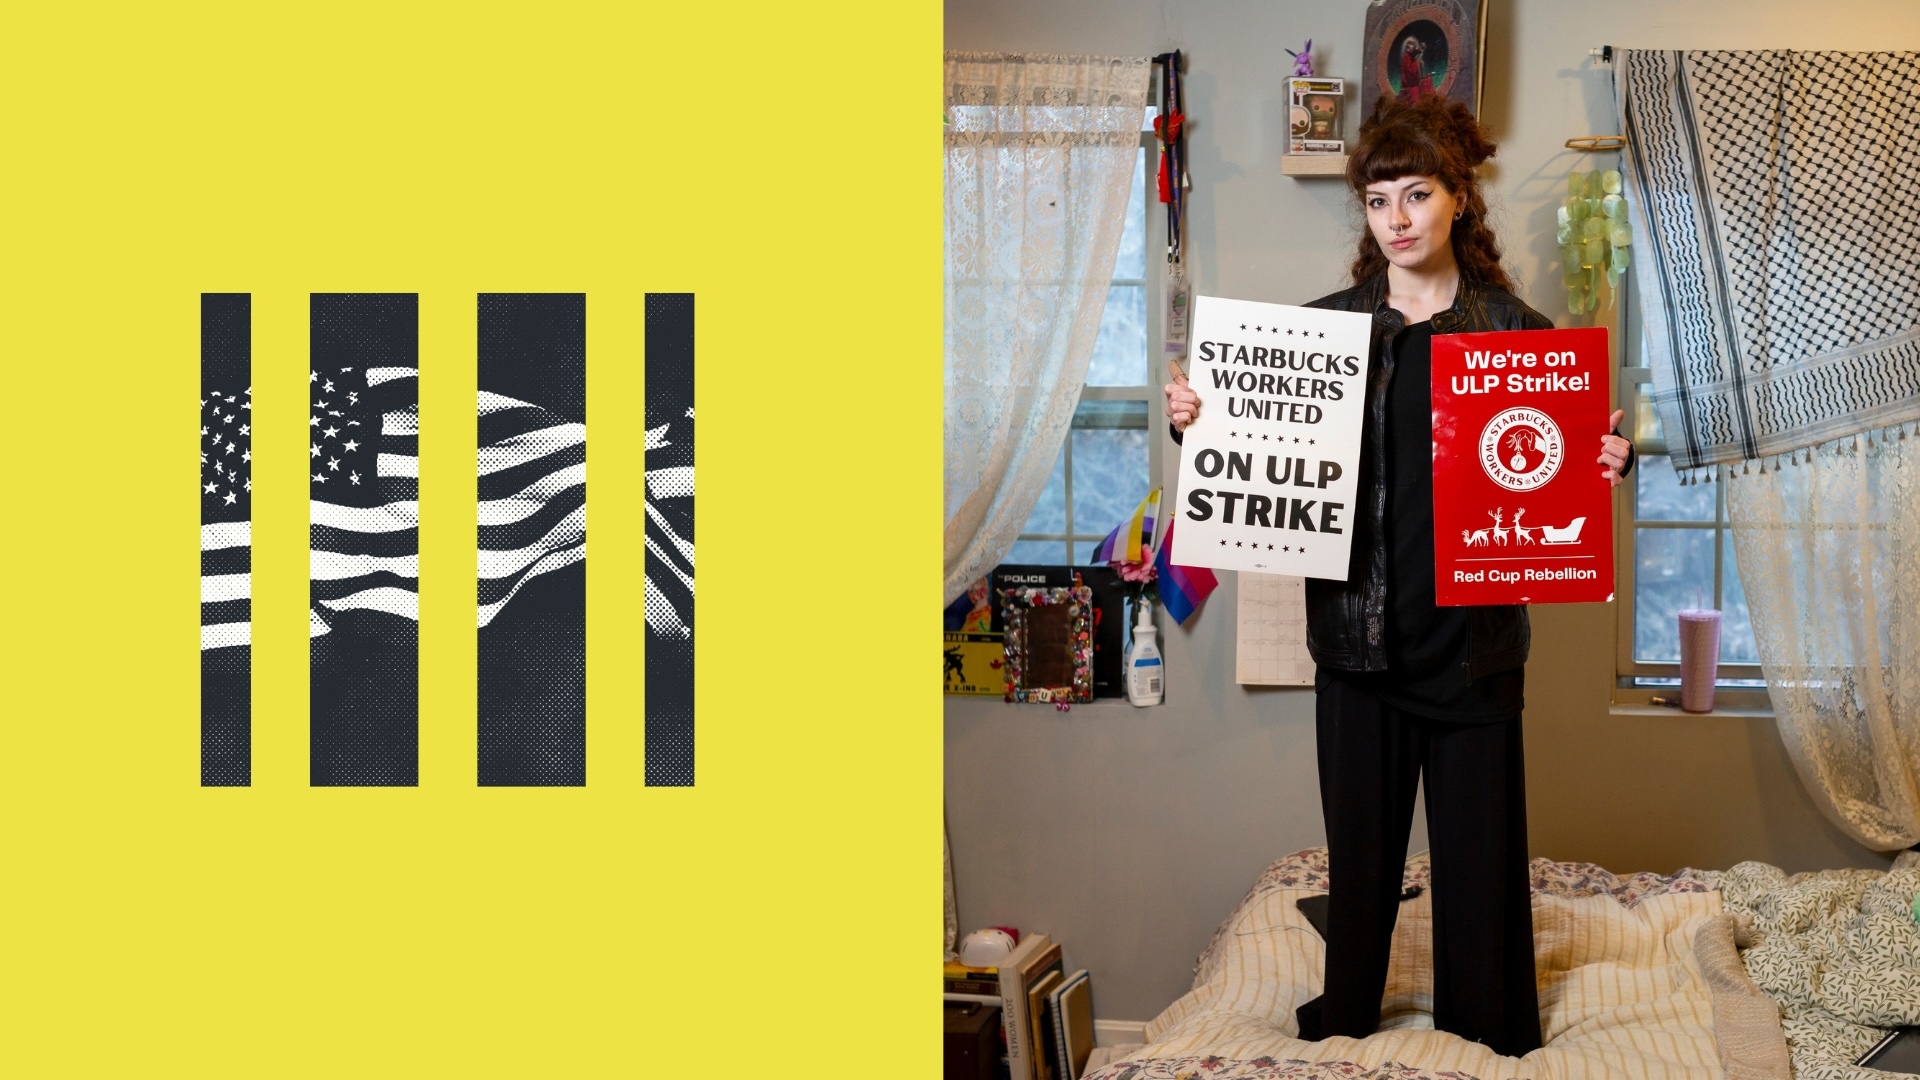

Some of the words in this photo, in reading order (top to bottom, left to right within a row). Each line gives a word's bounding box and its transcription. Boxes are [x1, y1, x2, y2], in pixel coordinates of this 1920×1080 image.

[1199, 340, 1360, 377] STARBUCKS
[1464, 349, 1537, 370] We're
[1544, 351, 1576, 367] on
[1211, 368, 1344, 401] WORKERS
[1451, 374, 1500, 395] ULP
[1506, 372, 1590, 394] Strike!
[1227, 396, 1323, 425] UNITED
[1490, 412, 1554, 437] STARBUCKS
[1194, 448, 1252, 482] ON
[1266, 455, 1343, 489] ULP
[1485, 443, 1524, 487] WORKERS
[1532, 442, 1559, 485] UNITED
[1186, 488, 1345, 535] STRIKE
[1004, 575, 1046, 583] POLICE
[1454, 570, 1484, 583] Red
[1488, 569, 1521, 585] Cup
[1524, 567, 1597, 581] Rebellion
[1005, 998, 1016, 1018] 200
[1008, 1020, 1019, 1058] WOMEN
